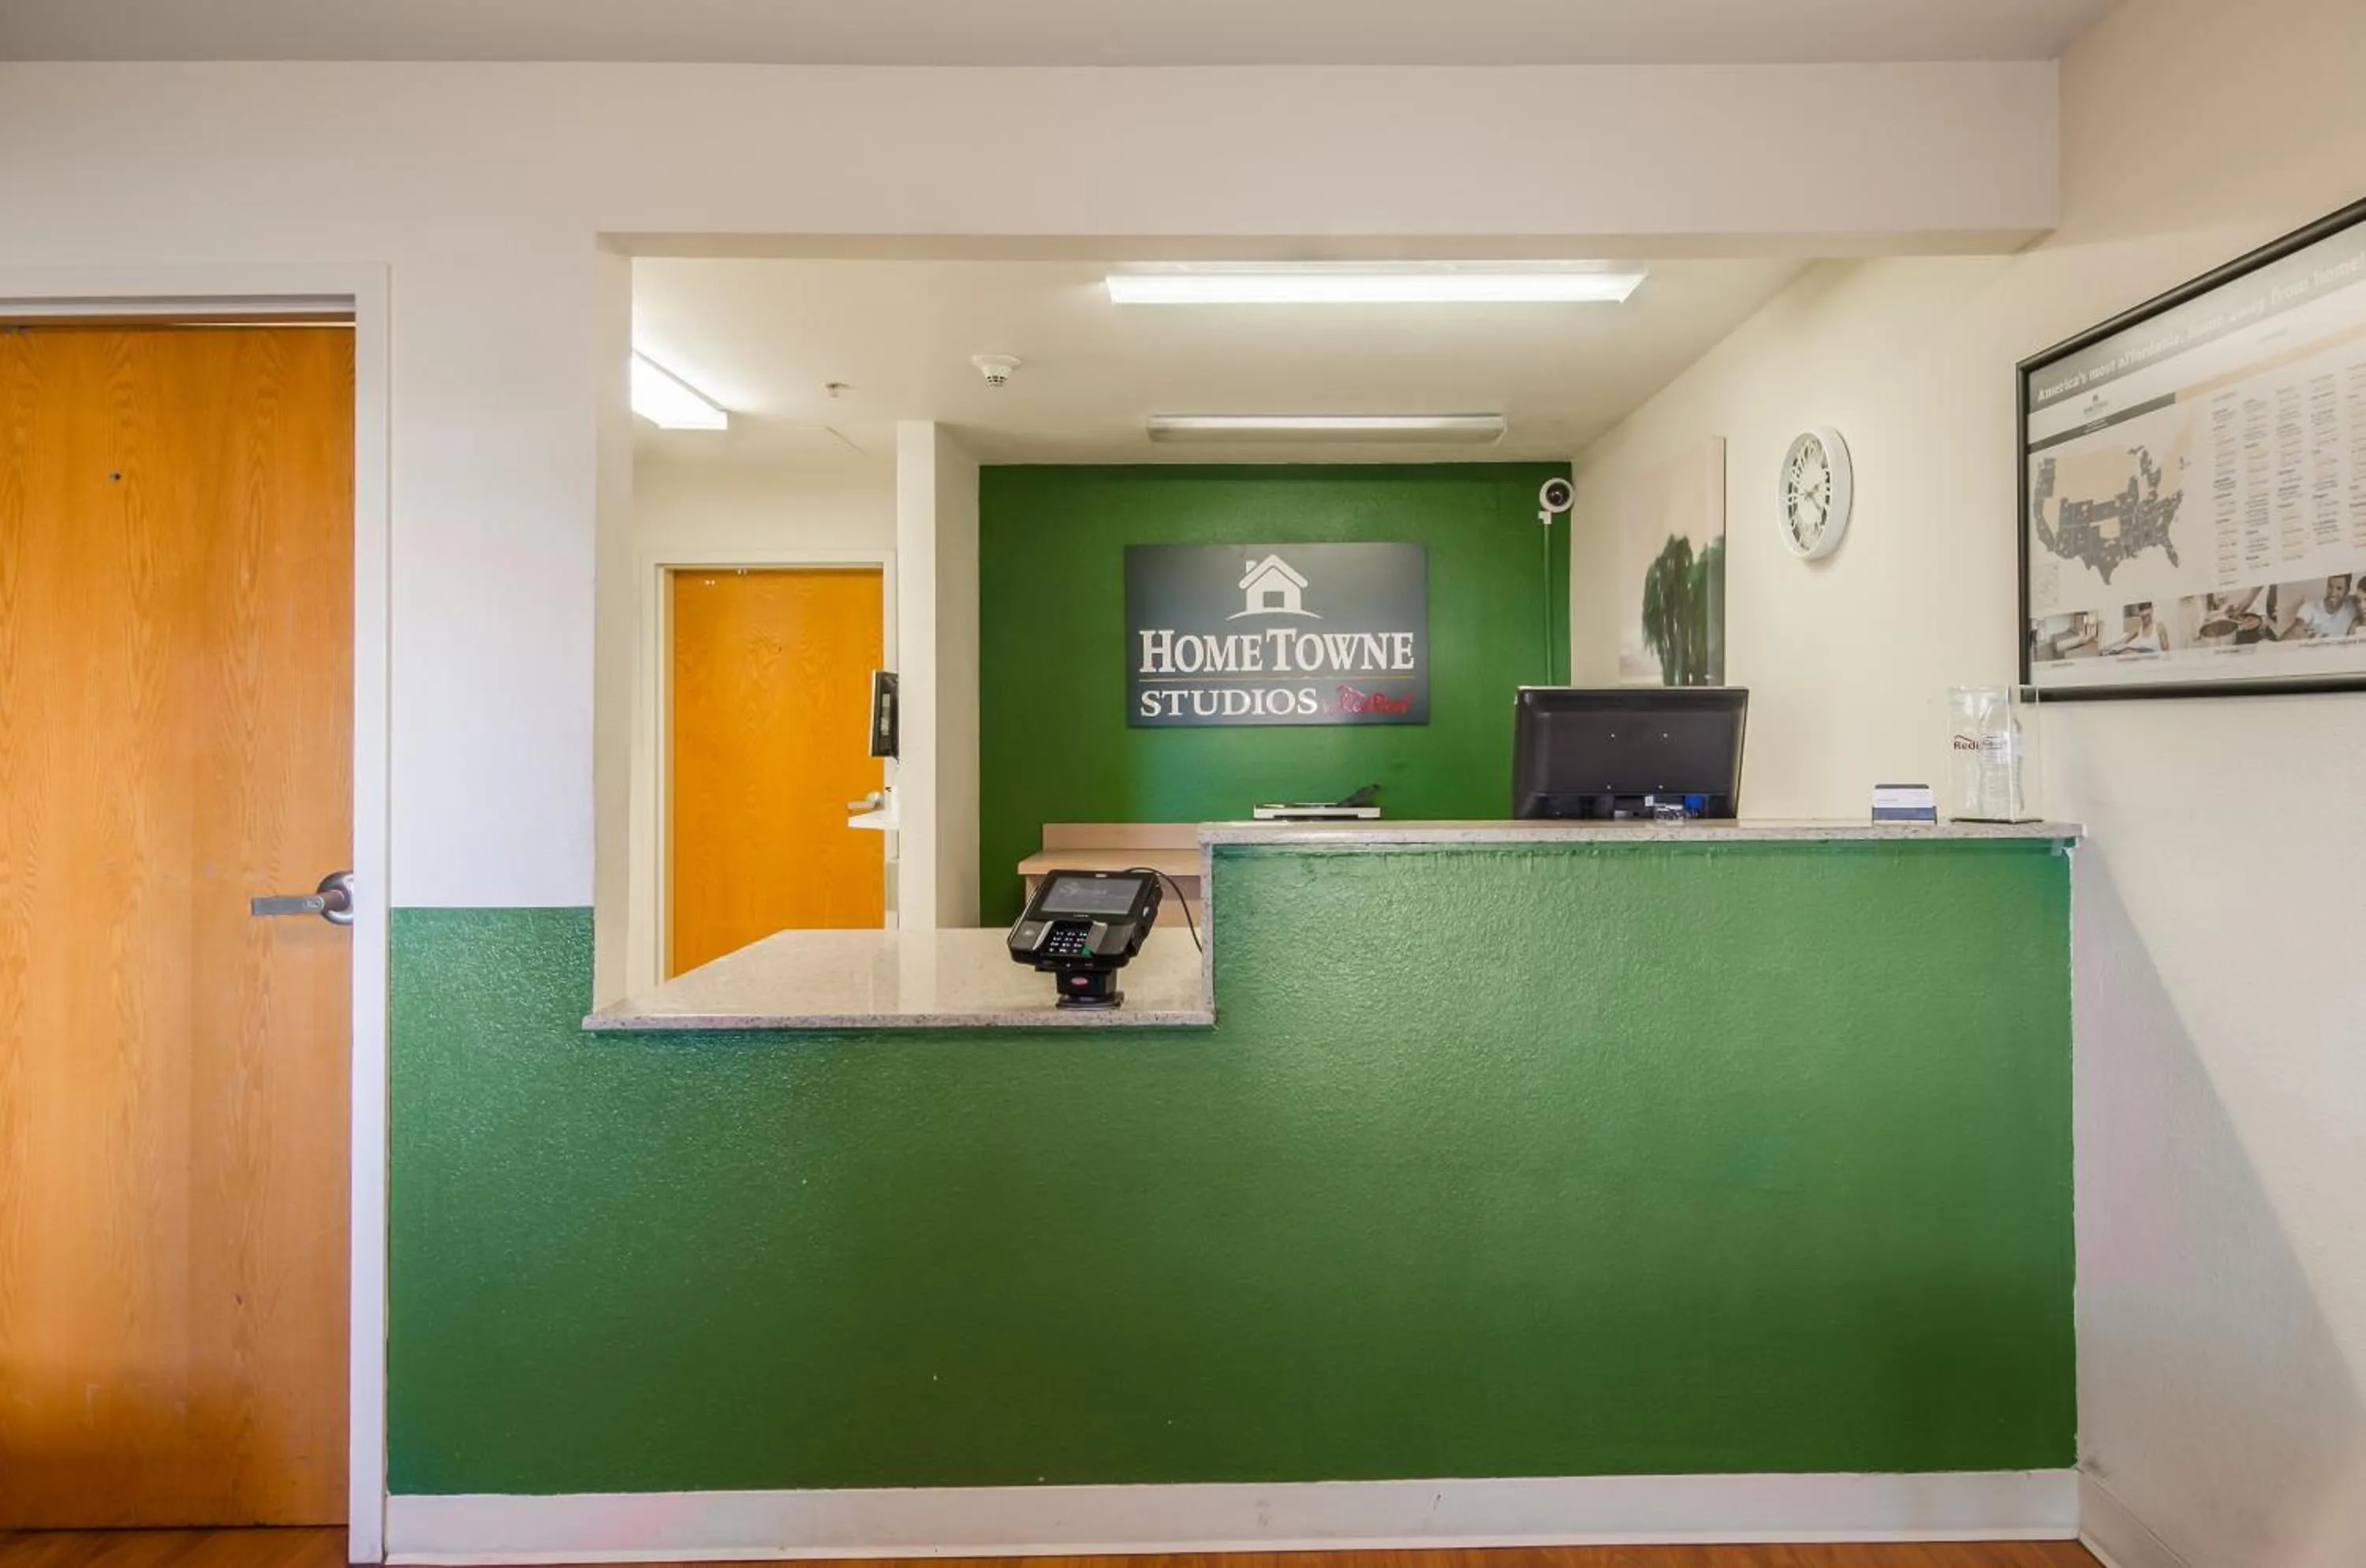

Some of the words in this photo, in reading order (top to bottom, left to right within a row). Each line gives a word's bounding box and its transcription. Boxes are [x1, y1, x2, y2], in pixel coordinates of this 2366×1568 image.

[2037, 371, 2087, 403] America's
[2089, 359, 2116, 381] most
[2271, 278, 2308, 304] from
[1140, 689, 1317, 717] STUDIOS
